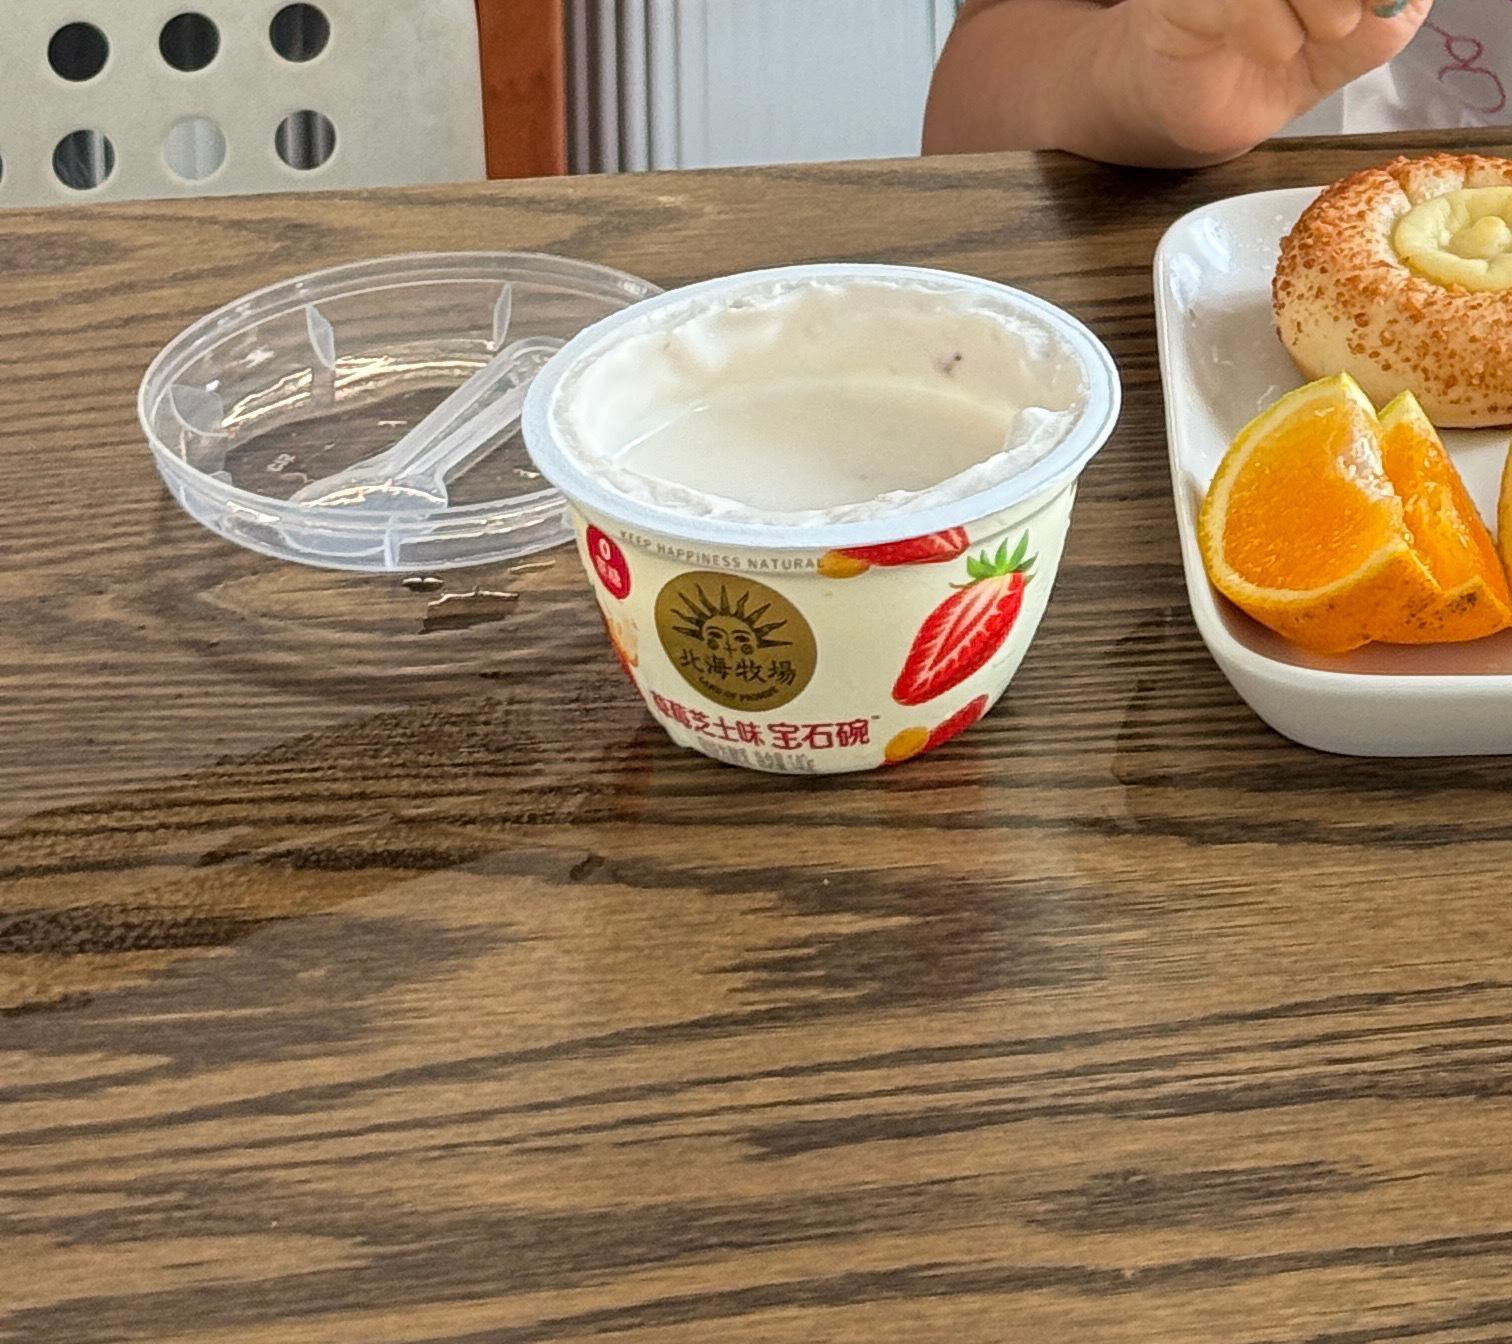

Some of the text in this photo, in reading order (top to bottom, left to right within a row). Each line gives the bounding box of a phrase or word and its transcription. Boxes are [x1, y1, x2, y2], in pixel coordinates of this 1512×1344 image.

[657, 542, 741, 569] HAPPINESS
[747, 557, 824, 570] NATURAL
[679, 648, 797, 686] 北海牧場
[767, 718, 870, 750] 宝石碗
